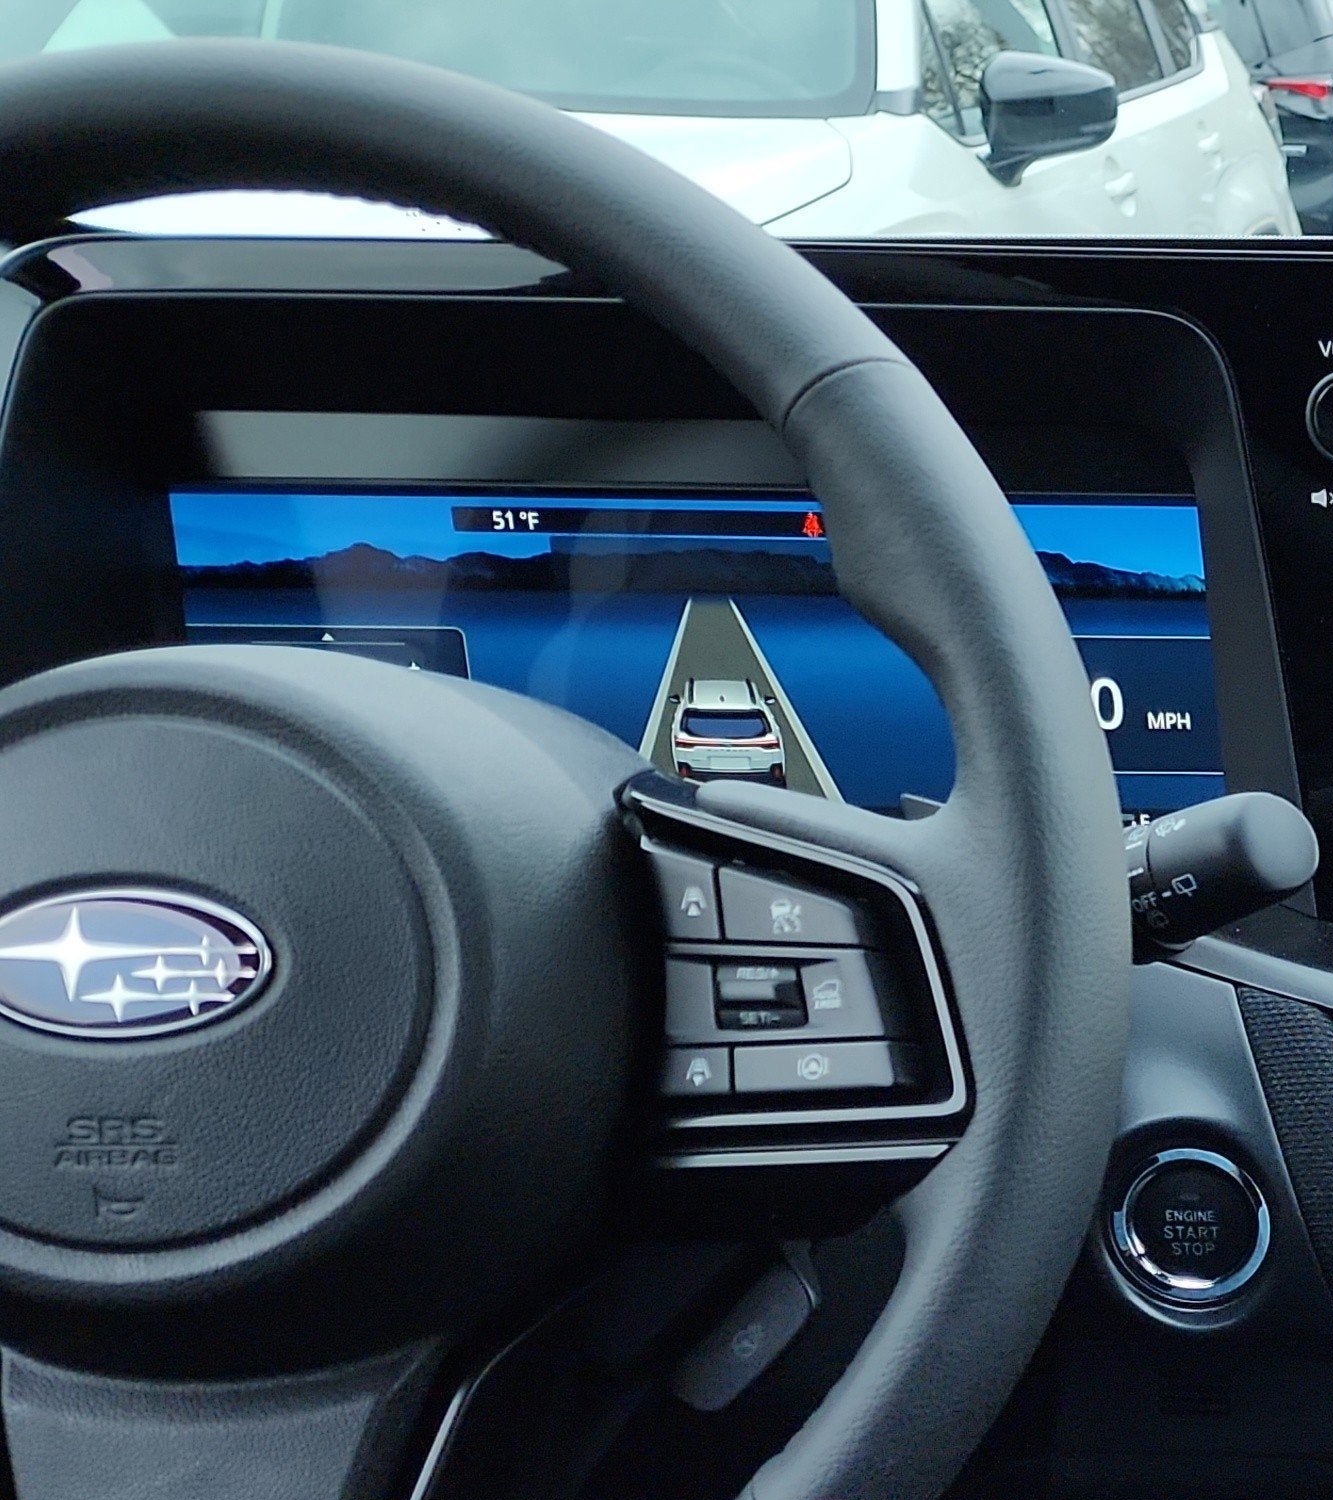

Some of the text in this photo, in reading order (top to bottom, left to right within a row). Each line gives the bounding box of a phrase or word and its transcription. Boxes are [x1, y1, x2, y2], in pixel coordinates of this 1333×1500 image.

[1146, 711, 1191, 730] MPH
[1164, 1209, 1217, 1222] ENGINE
[1163, 1225, 1219, 1240] START
[1171, 1242, 1215, 1256] STOP
